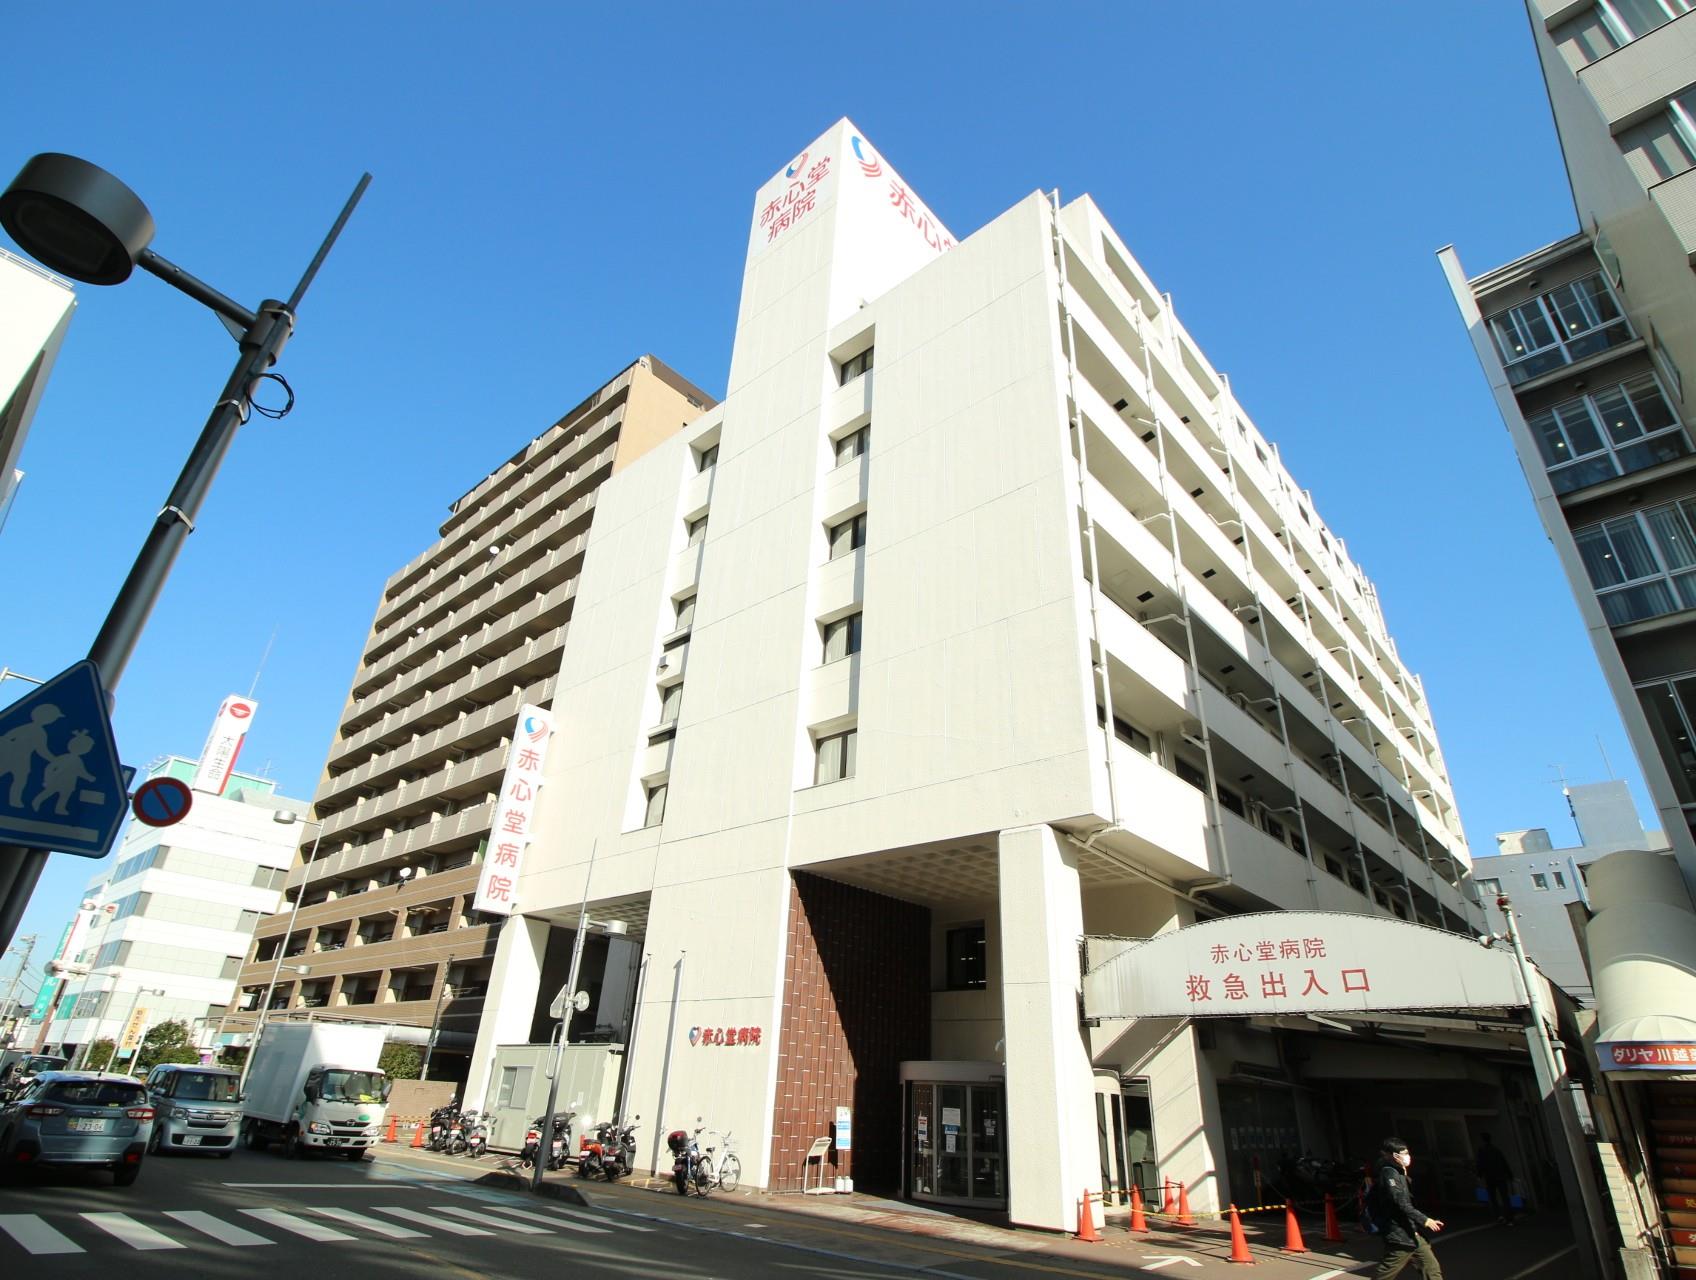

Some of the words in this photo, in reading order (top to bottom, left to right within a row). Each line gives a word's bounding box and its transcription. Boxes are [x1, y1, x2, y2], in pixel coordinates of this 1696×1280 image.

[760, 156, 831, 228] 赤心堂
[767, 189, 817, 243] 病院
[486, 748, 541, 902] 赤心堂病院
[1210, 937, 1327, 964] 赤心堂病院
[1185, 968, 1370, 1002] 救急出入口
[702, 1026, 762, 1046] 赤心堂病院
